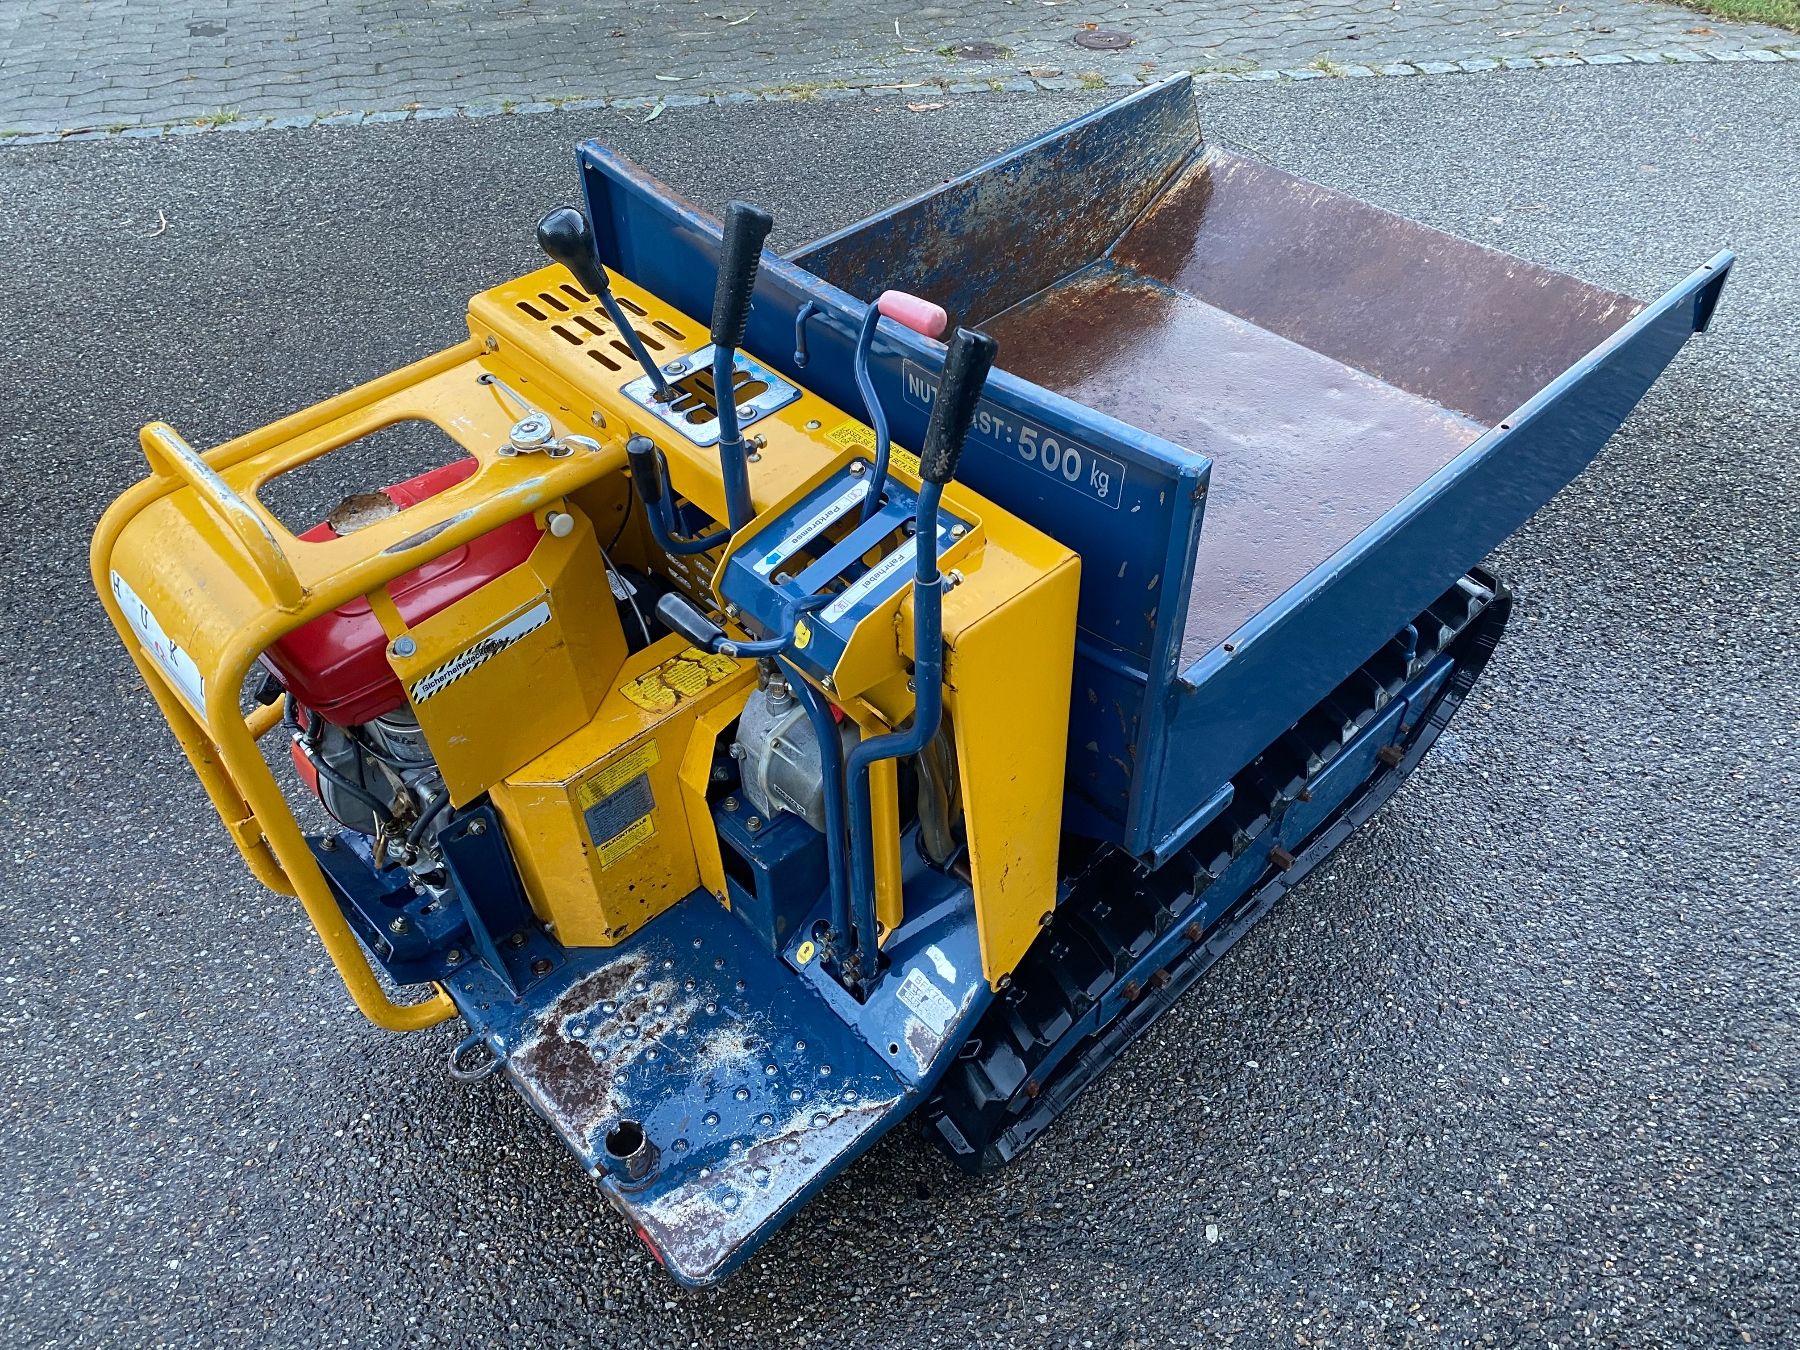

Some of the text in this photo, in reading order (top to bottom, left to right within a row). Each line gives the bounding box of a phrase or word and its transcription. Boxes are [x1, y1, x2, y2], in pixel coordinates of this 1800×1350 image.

[1018, 425, 1082, 482] 500
[1090, 459, 1110, 498] kg
[791, 505, 841, 545] Parkbremse
[863, 554, 906, 590] Fahrhebel
